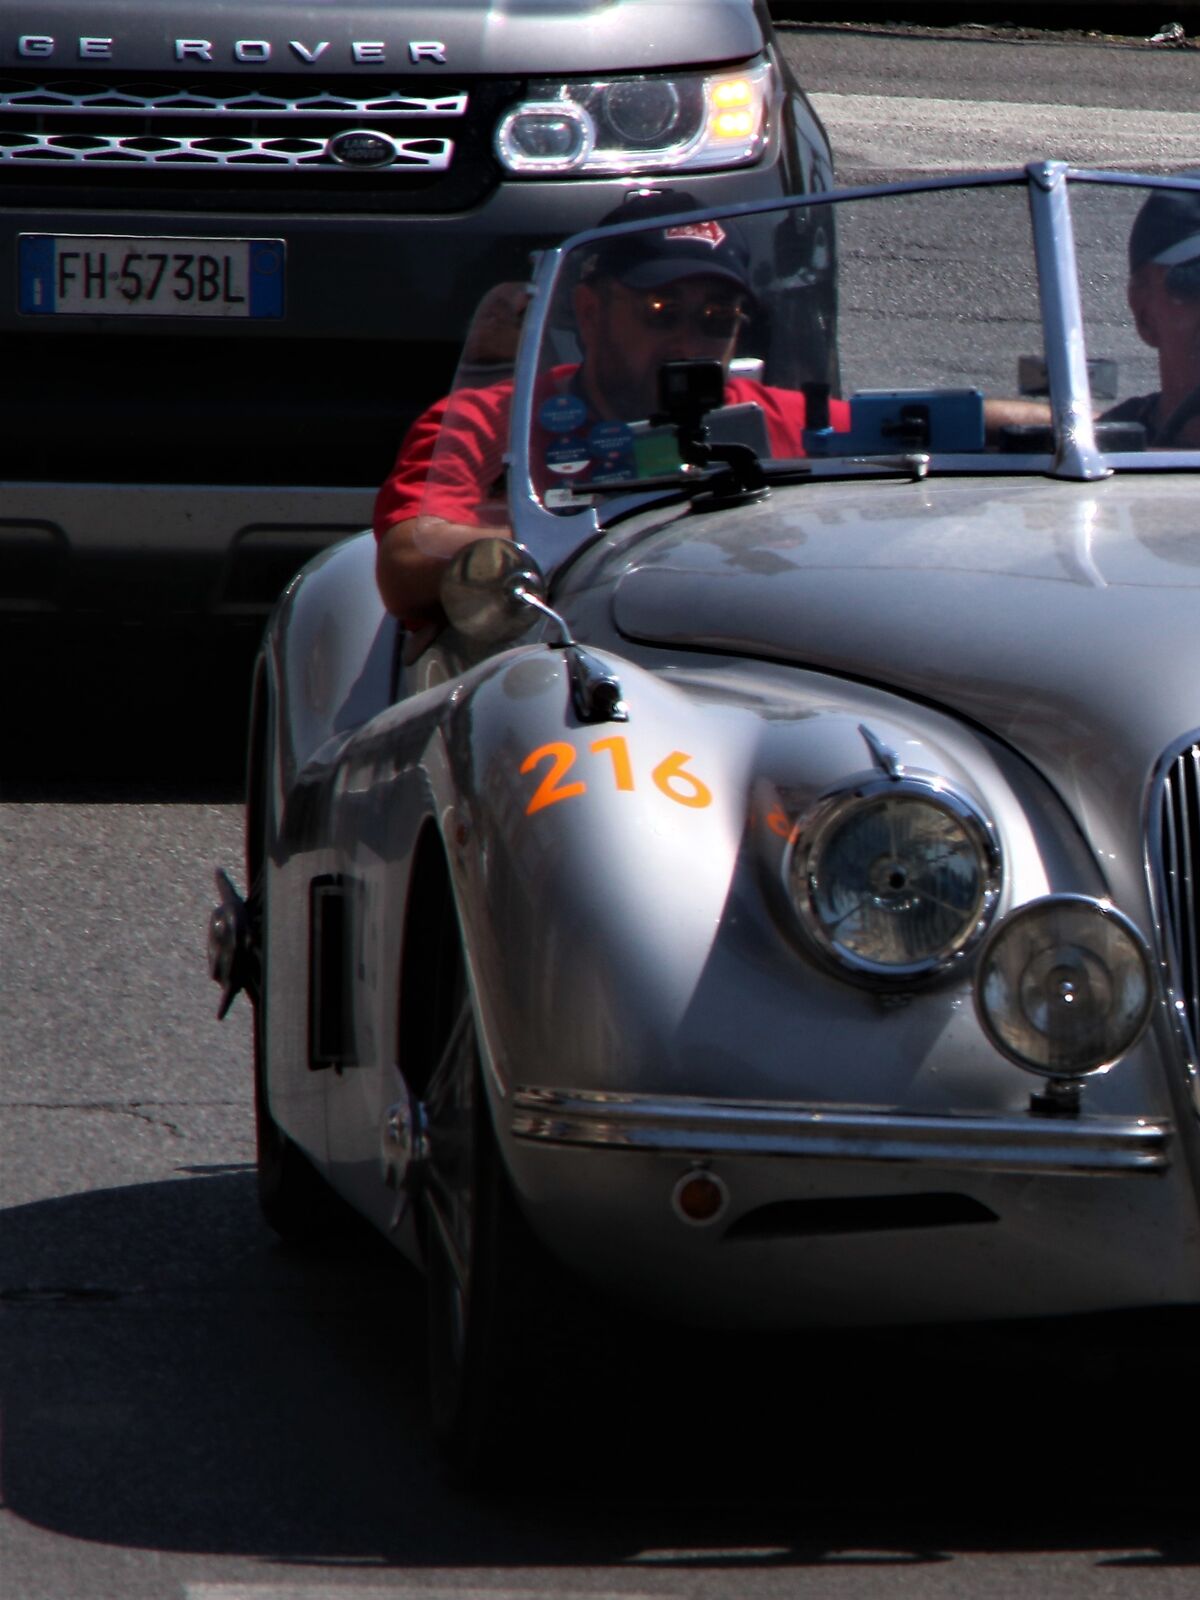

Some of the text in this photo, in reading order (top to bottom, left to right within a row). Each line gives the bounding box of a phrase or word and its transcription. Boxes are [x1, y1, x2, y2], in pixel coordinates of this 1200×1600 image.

[18, 35, 447, 63] GE ROVER
[519, 735, 713, 817] 216
